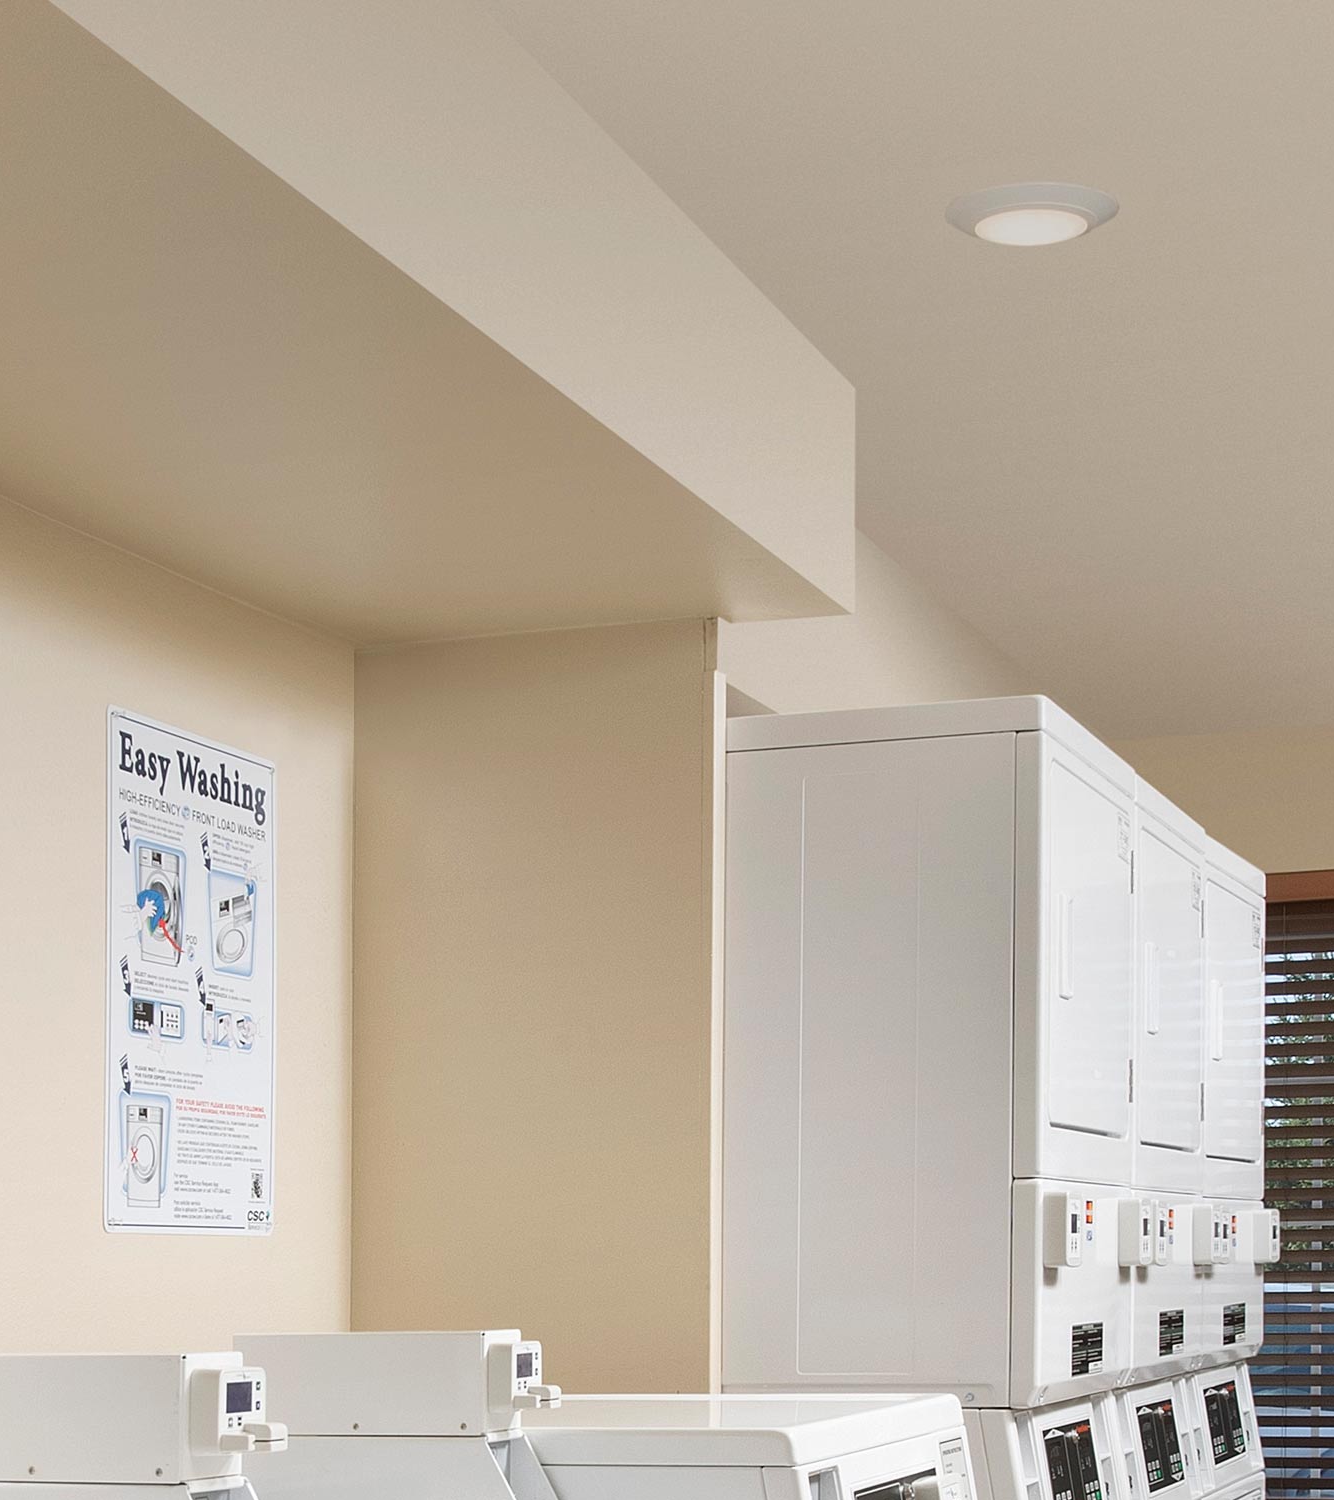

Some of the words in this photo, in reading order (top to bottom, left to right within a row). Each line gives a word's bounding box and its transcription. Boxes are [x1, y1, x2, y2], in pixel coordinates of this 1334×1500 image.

[119, 730, 171, 796] Easy
[176, 750, 266, 825] Washing
[119, 787, 180, 817] HIGH-EFFICIENCY
[192, 810, 215, 827] FRONT
[217, 818, 236, 833] LOAD
[237, 822, 266, 842] WASHER
[247, 1211, 264, 1222] CSC
